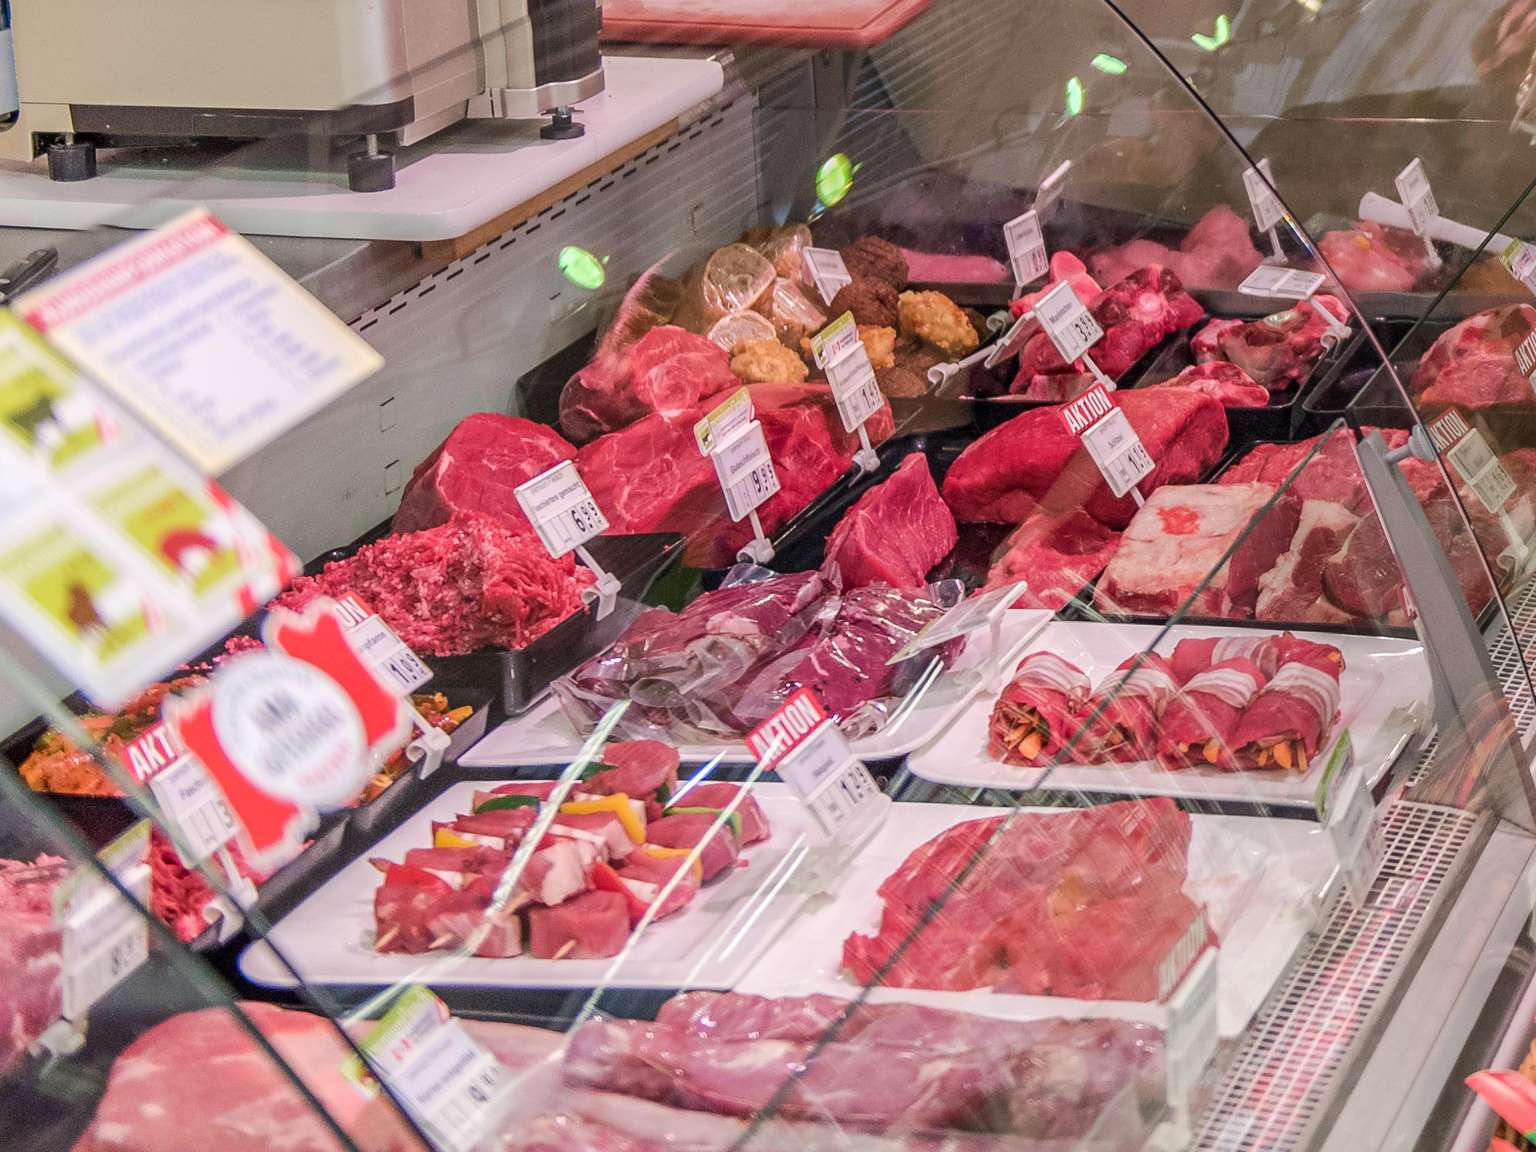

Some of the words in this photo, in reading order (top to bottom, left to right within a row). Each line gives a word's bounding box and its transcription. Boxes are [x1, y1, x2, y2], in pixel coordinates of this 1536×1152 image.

[1063, 386, 1113, 434] AKTION
[570, 501, 598, 532] 6.99
[751, 694, 822, 762] AKTION
